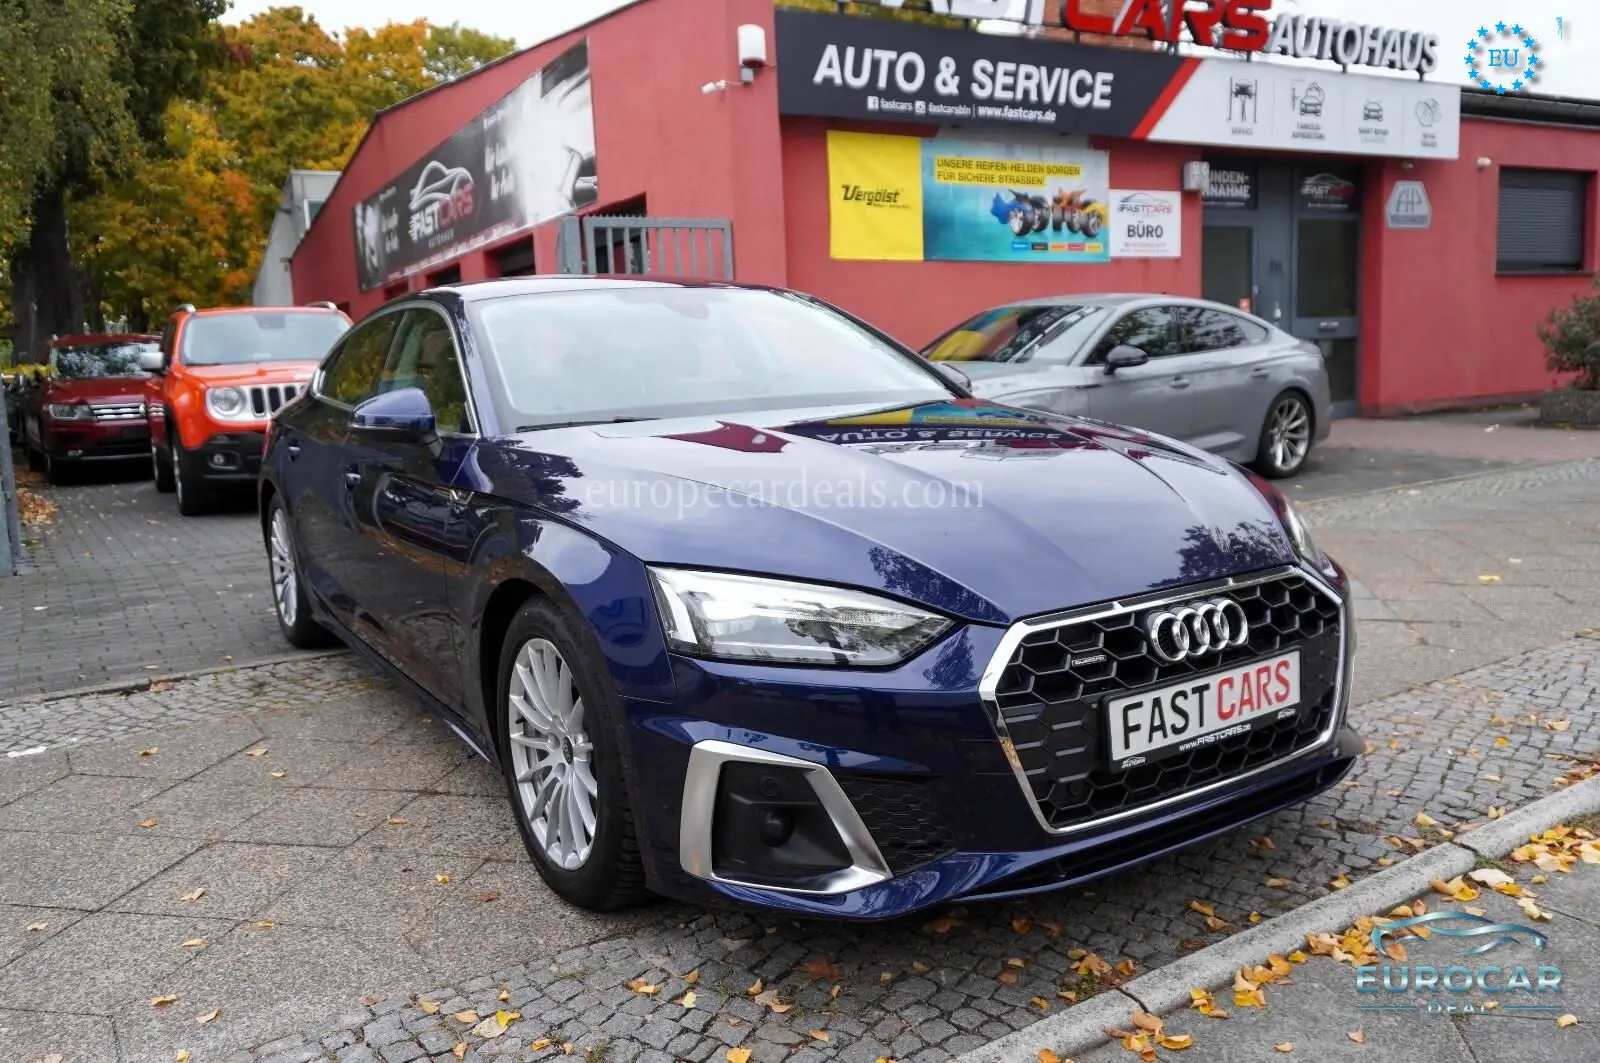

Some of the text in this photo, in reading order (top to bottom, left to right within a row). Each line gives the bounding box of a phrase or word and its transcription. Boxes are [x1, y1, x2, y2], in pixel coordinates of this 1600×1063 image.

[1268, 12, 1438, 74] AUTOHAUS
[813, 43, 1114, 109] AUTO & SERVICE
[880, 98, 913, 112] fastcars
[978, 105, 1057, 121] www.fastcars.de
[936, 158, 1081, 176] UNSERE REIFEN-HELDEN SORGEN
[936, 170, 1046, 185] FÜR SICHERE STRASSEN!
[841, 184, 901, 206] Vergölst
[1127, 220, 1164, 238] BÜRO
[1122, 659, 1292, 750] FAST CARS
